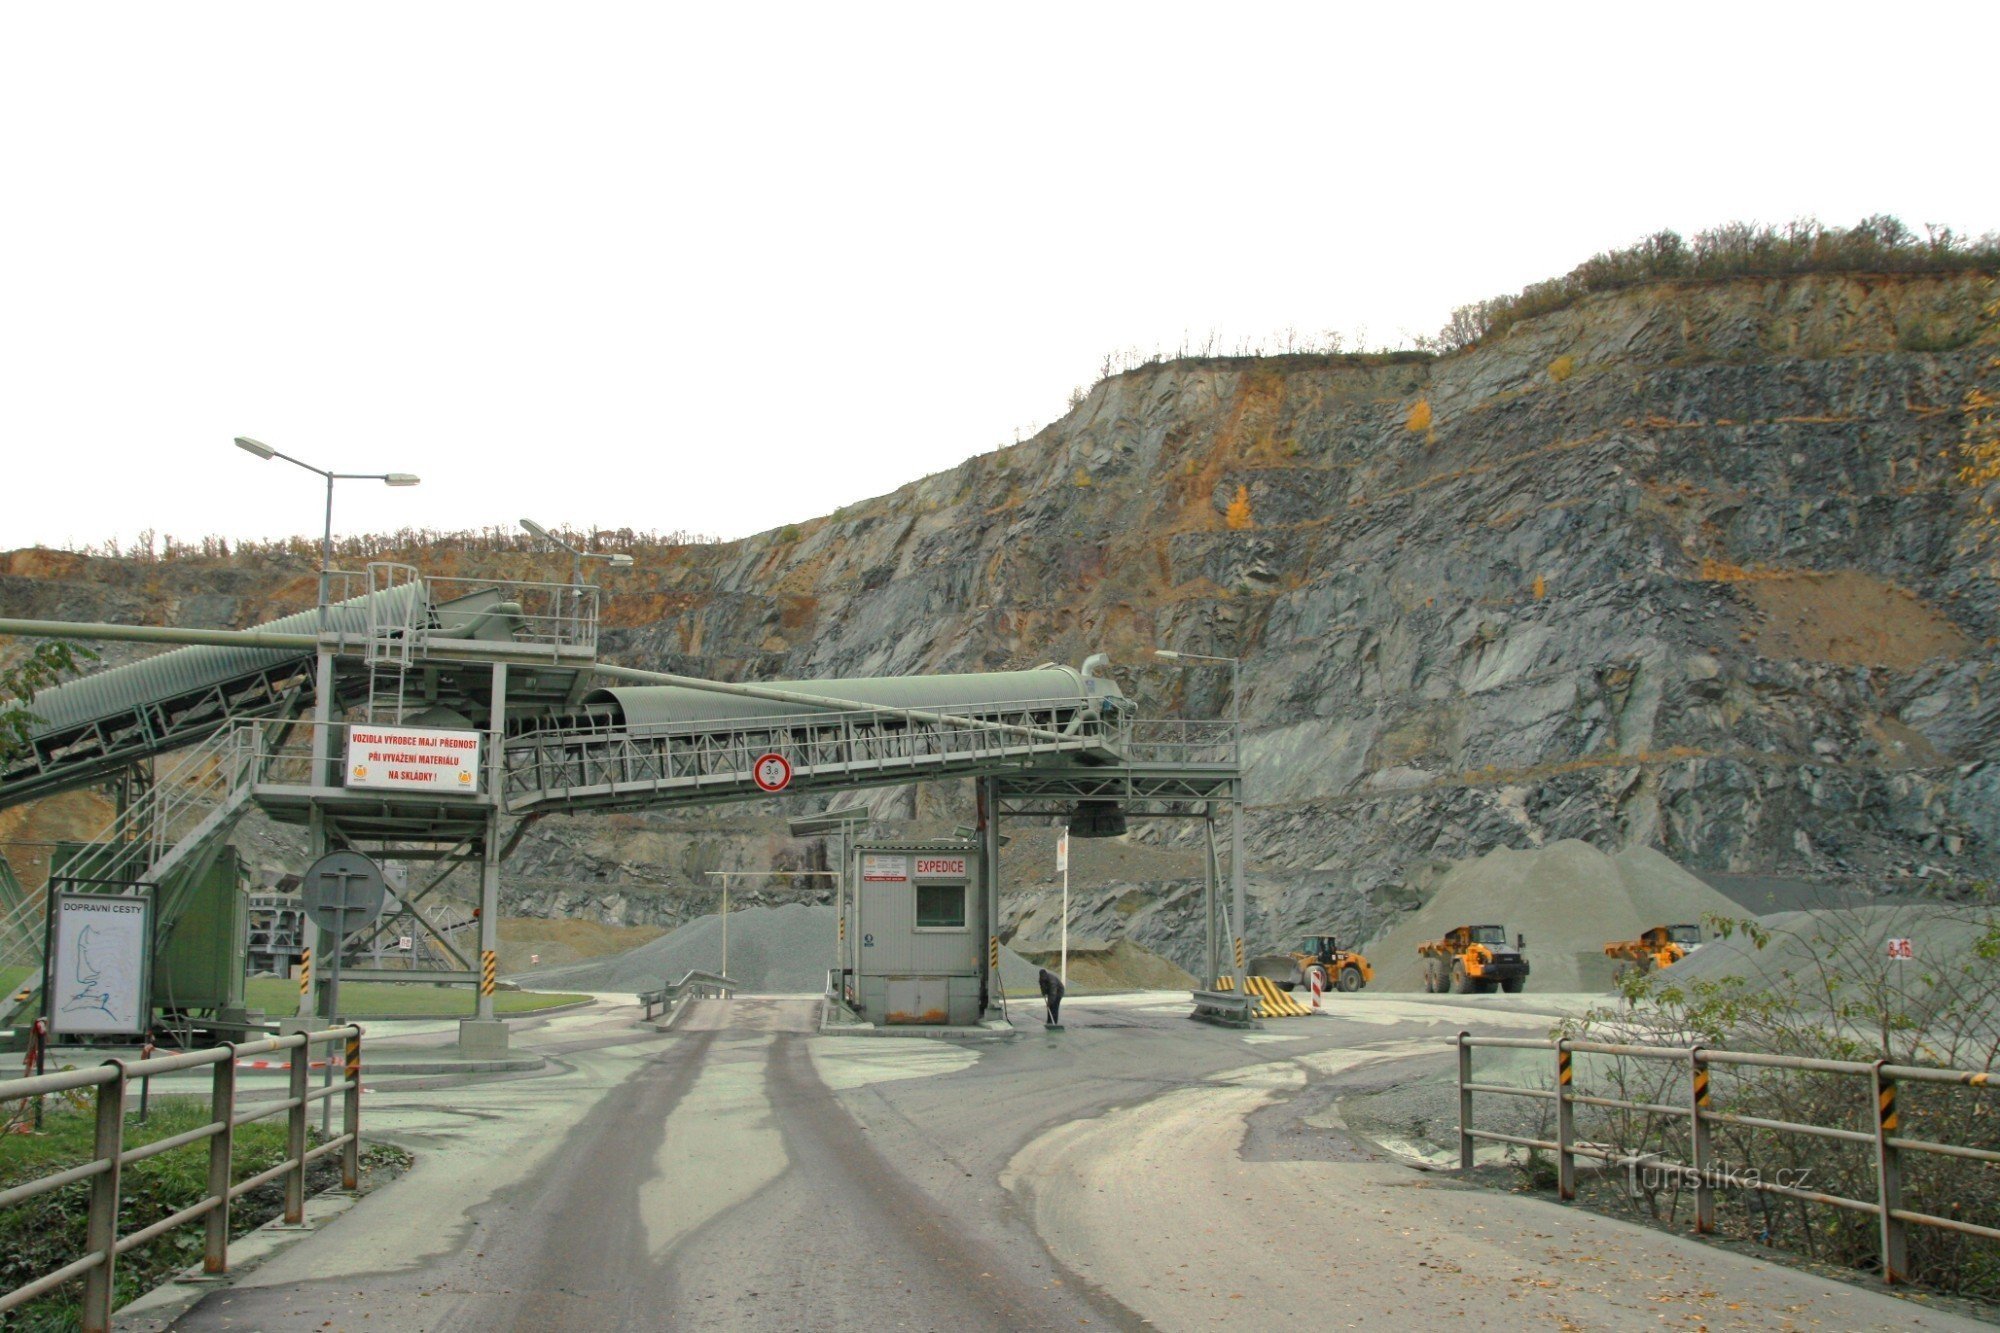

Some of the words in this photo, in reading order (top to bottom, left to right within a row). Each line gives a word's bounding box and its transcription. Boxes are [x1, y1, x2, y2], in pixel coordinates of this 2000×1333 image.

[352, 733, 382, 744] VOZIDLA
[384, 734, 417, 746] VÝROBCE
[418, 736, 437, 747] MAJÍ
[439, 737, 477, 749] PŘEDNOST
[368, 752, 381, 762] PŘI
[418, 754, 459, 766] MATERIÁLU
[388, 770, 399, 780] NA
[401, 769, 432, 782] SKLÁDKY
[917, 860, 964, 873] EXPEDICE
[63, 902, 111, 913] DOPRAVNÍ
[112, 905, 142, 914] CESTY
